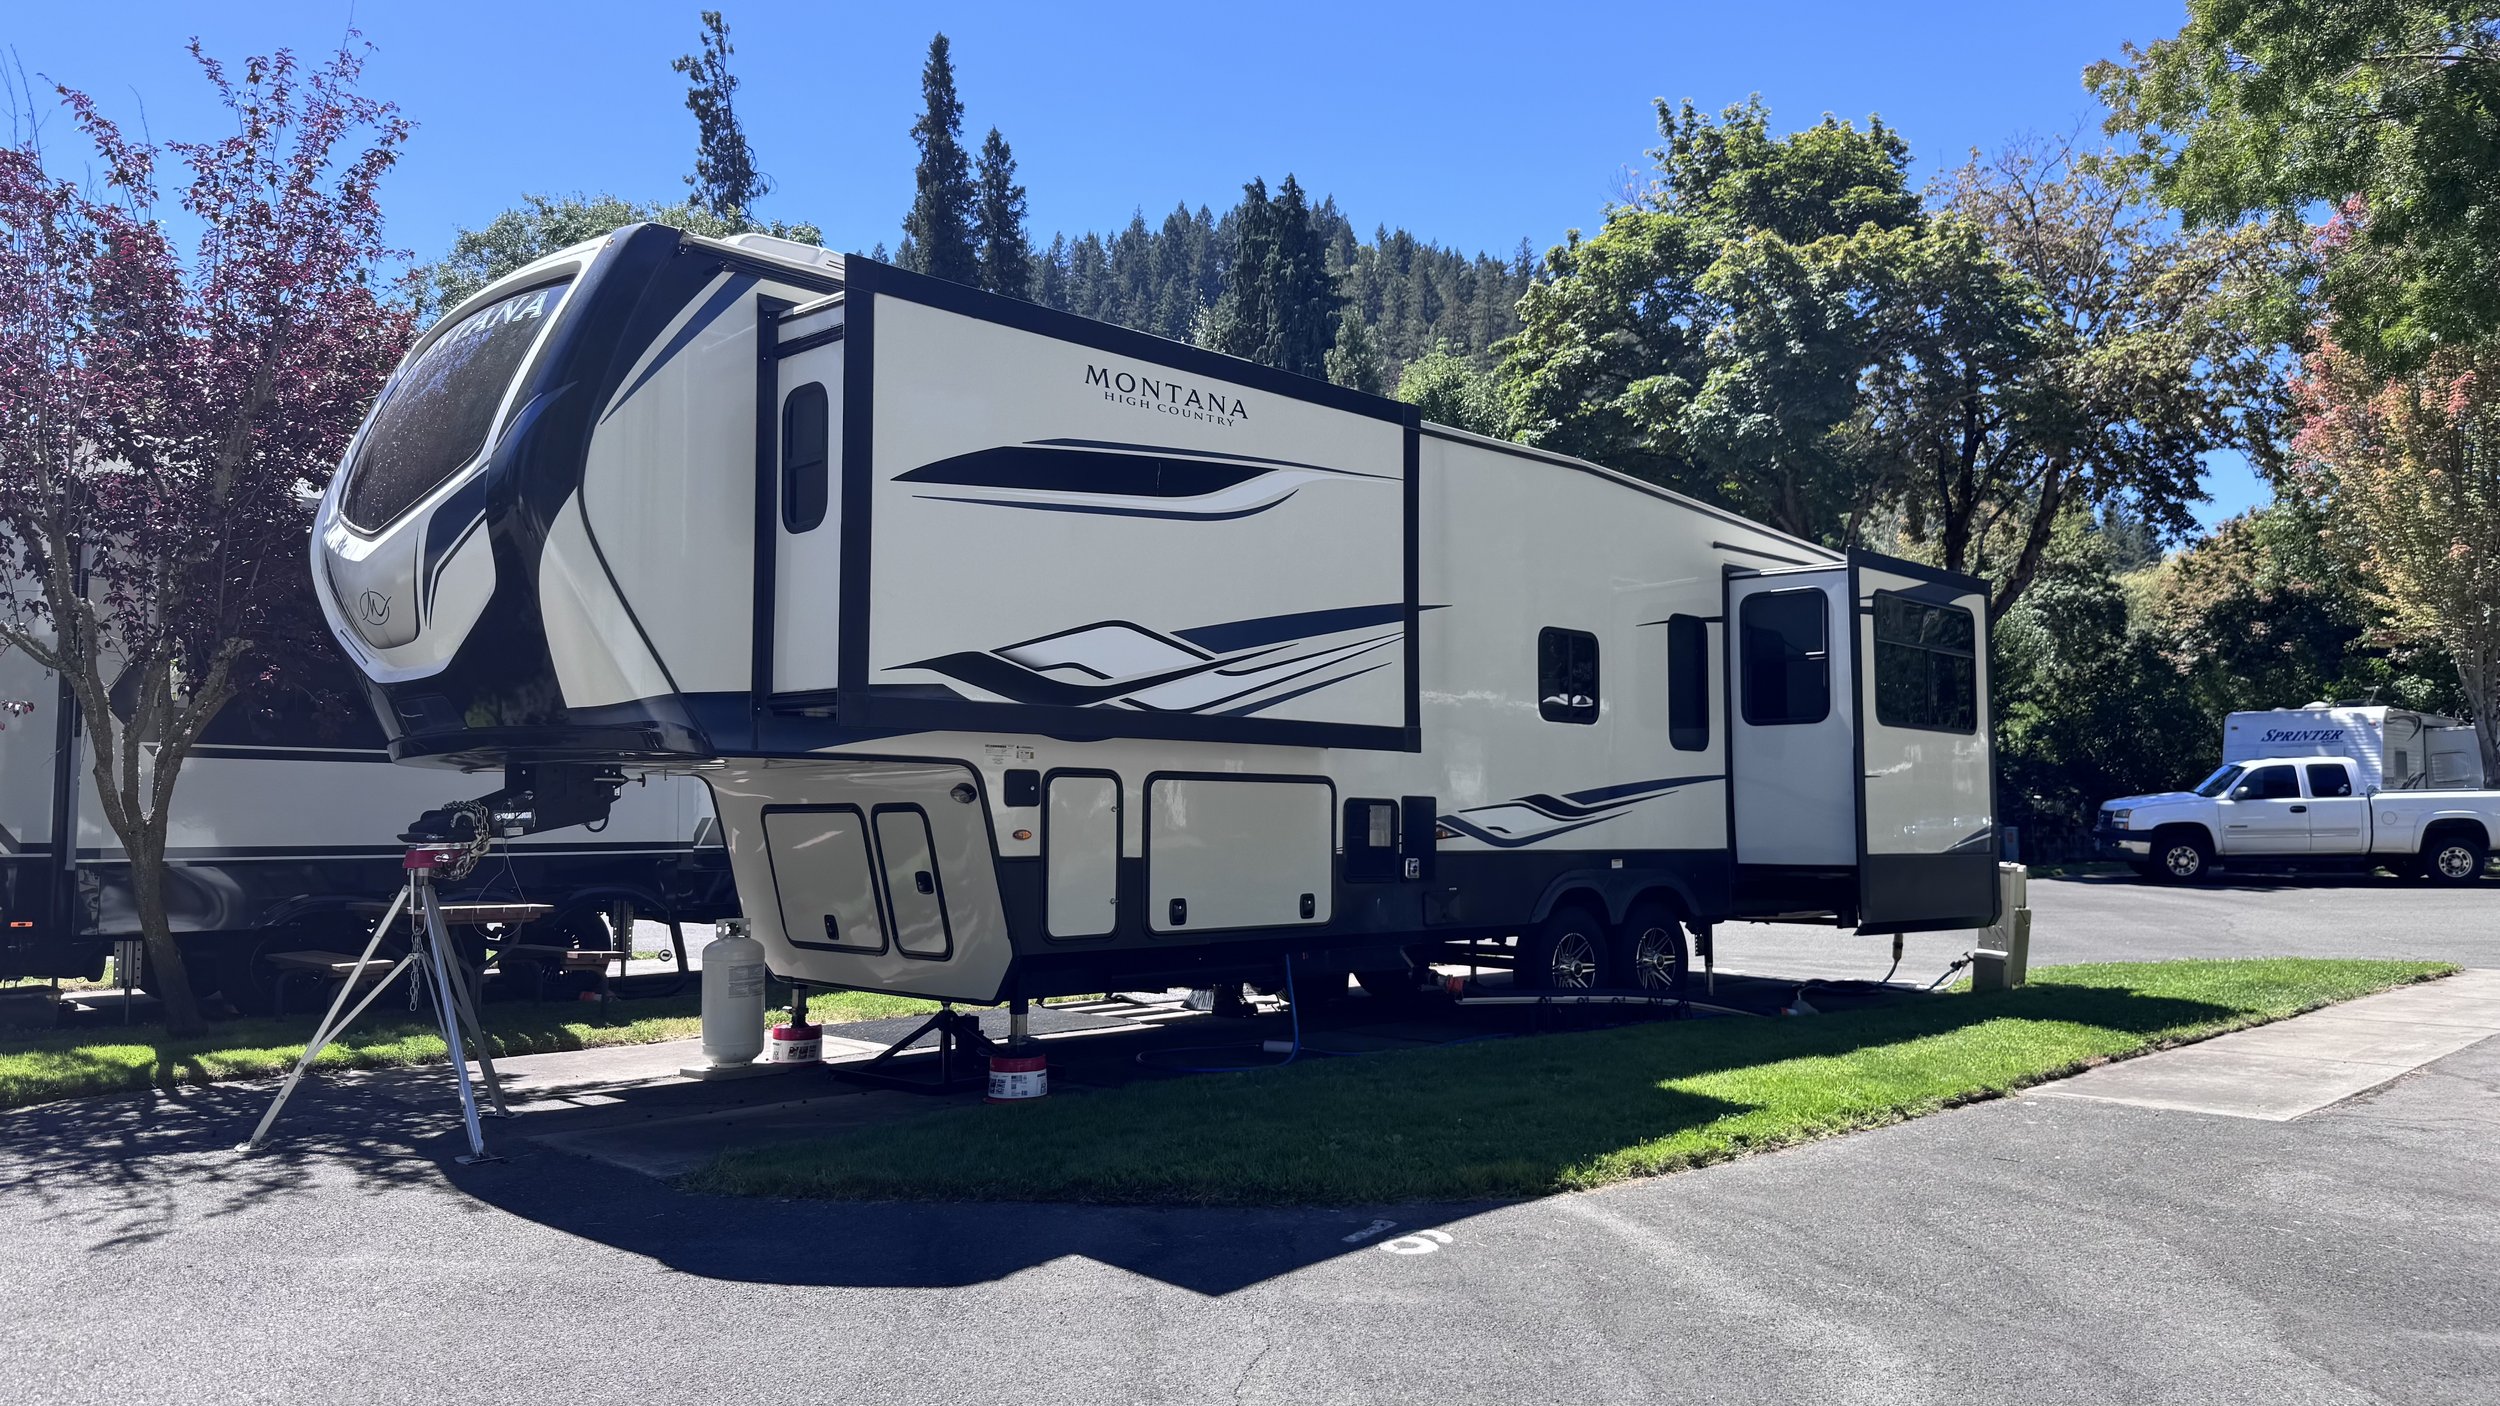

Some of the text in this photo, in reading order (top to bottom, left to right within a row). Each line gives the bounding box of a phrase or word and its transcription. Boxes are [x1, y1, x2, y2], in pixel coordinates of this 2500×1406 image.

[1085, 364, 1249, 420] MONTANA
[1104, 391, 1235, 427] HIGH COUNTRY
[1341, 1219, 1454, 1255] 16
